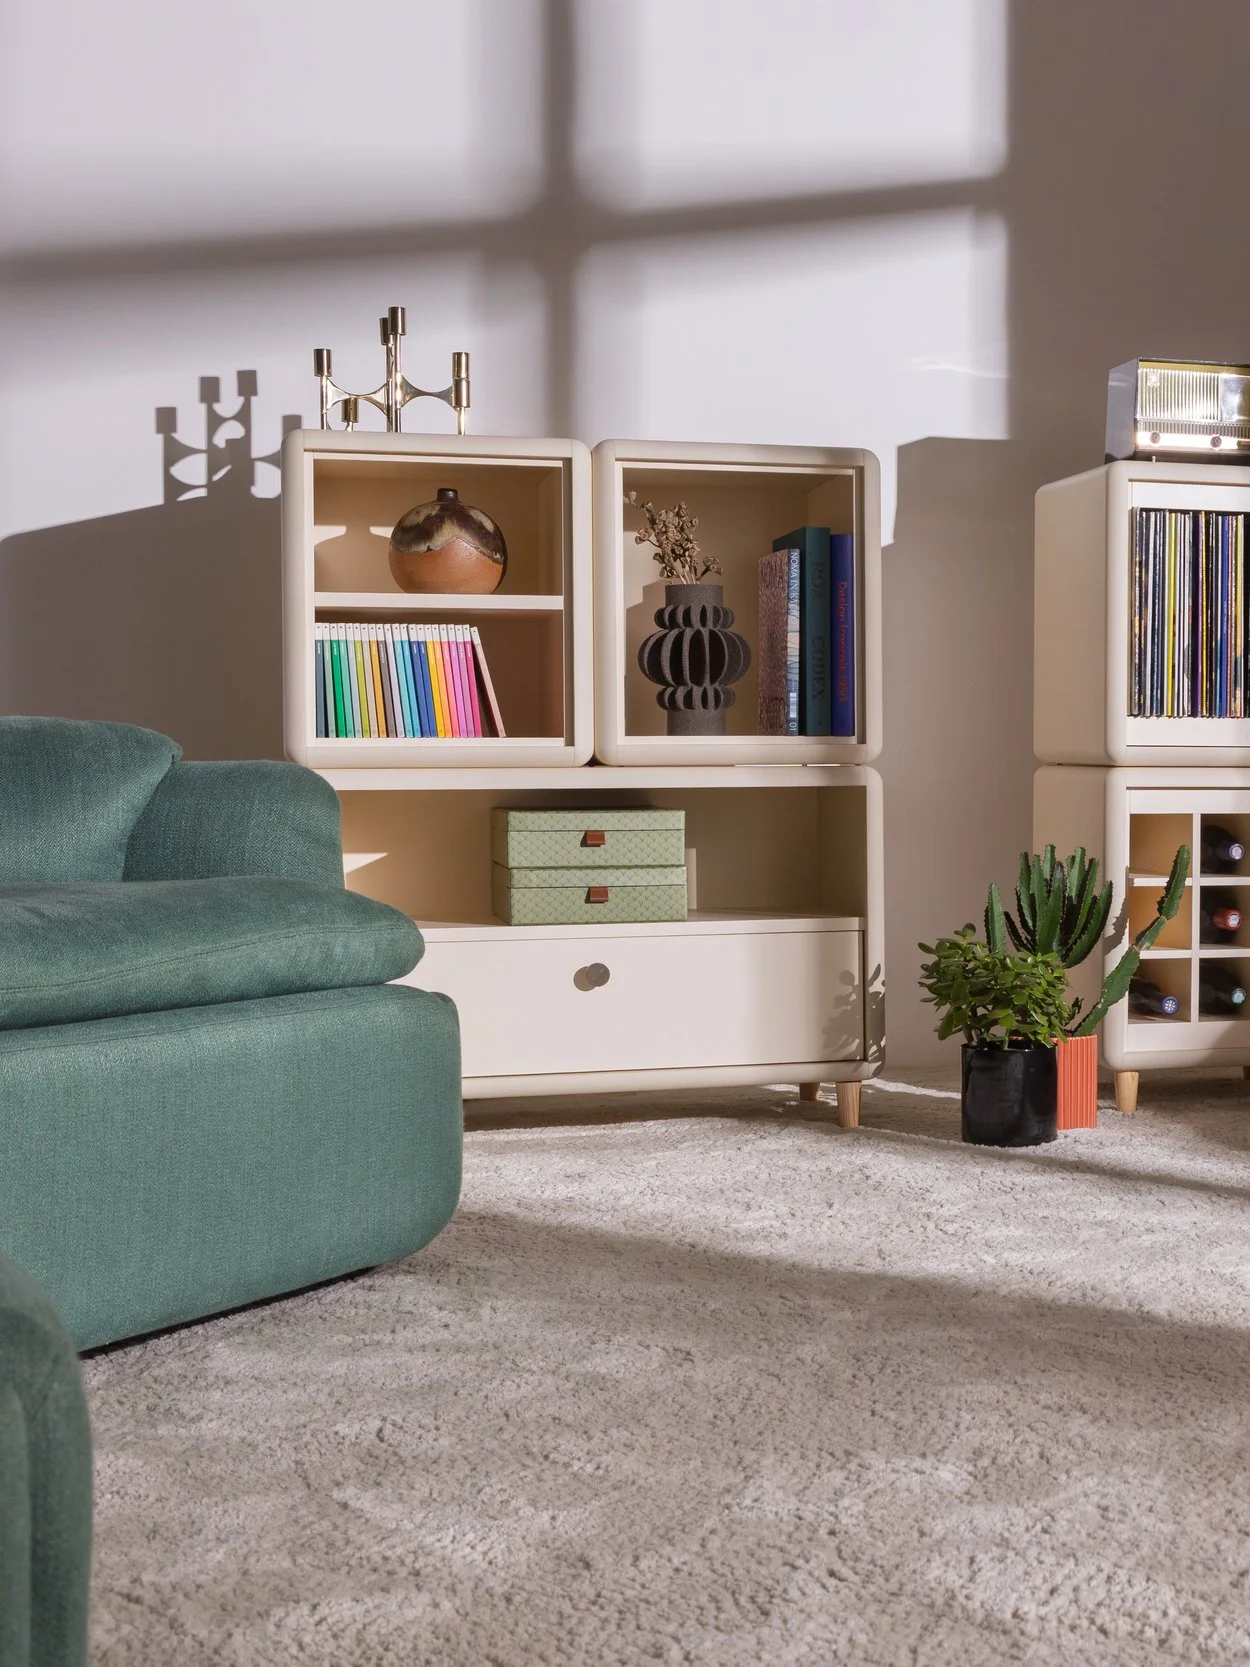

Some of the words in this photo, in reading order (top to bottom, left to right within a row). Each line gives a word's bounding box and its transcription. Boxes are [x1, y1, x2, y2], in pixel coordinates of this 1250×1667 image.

[790, 551, 798, 578] NOMA
[790, 579, 798, 590] IN
[811, 635, 825, 702] CODEX
[789, 722, 796, 731] 01
